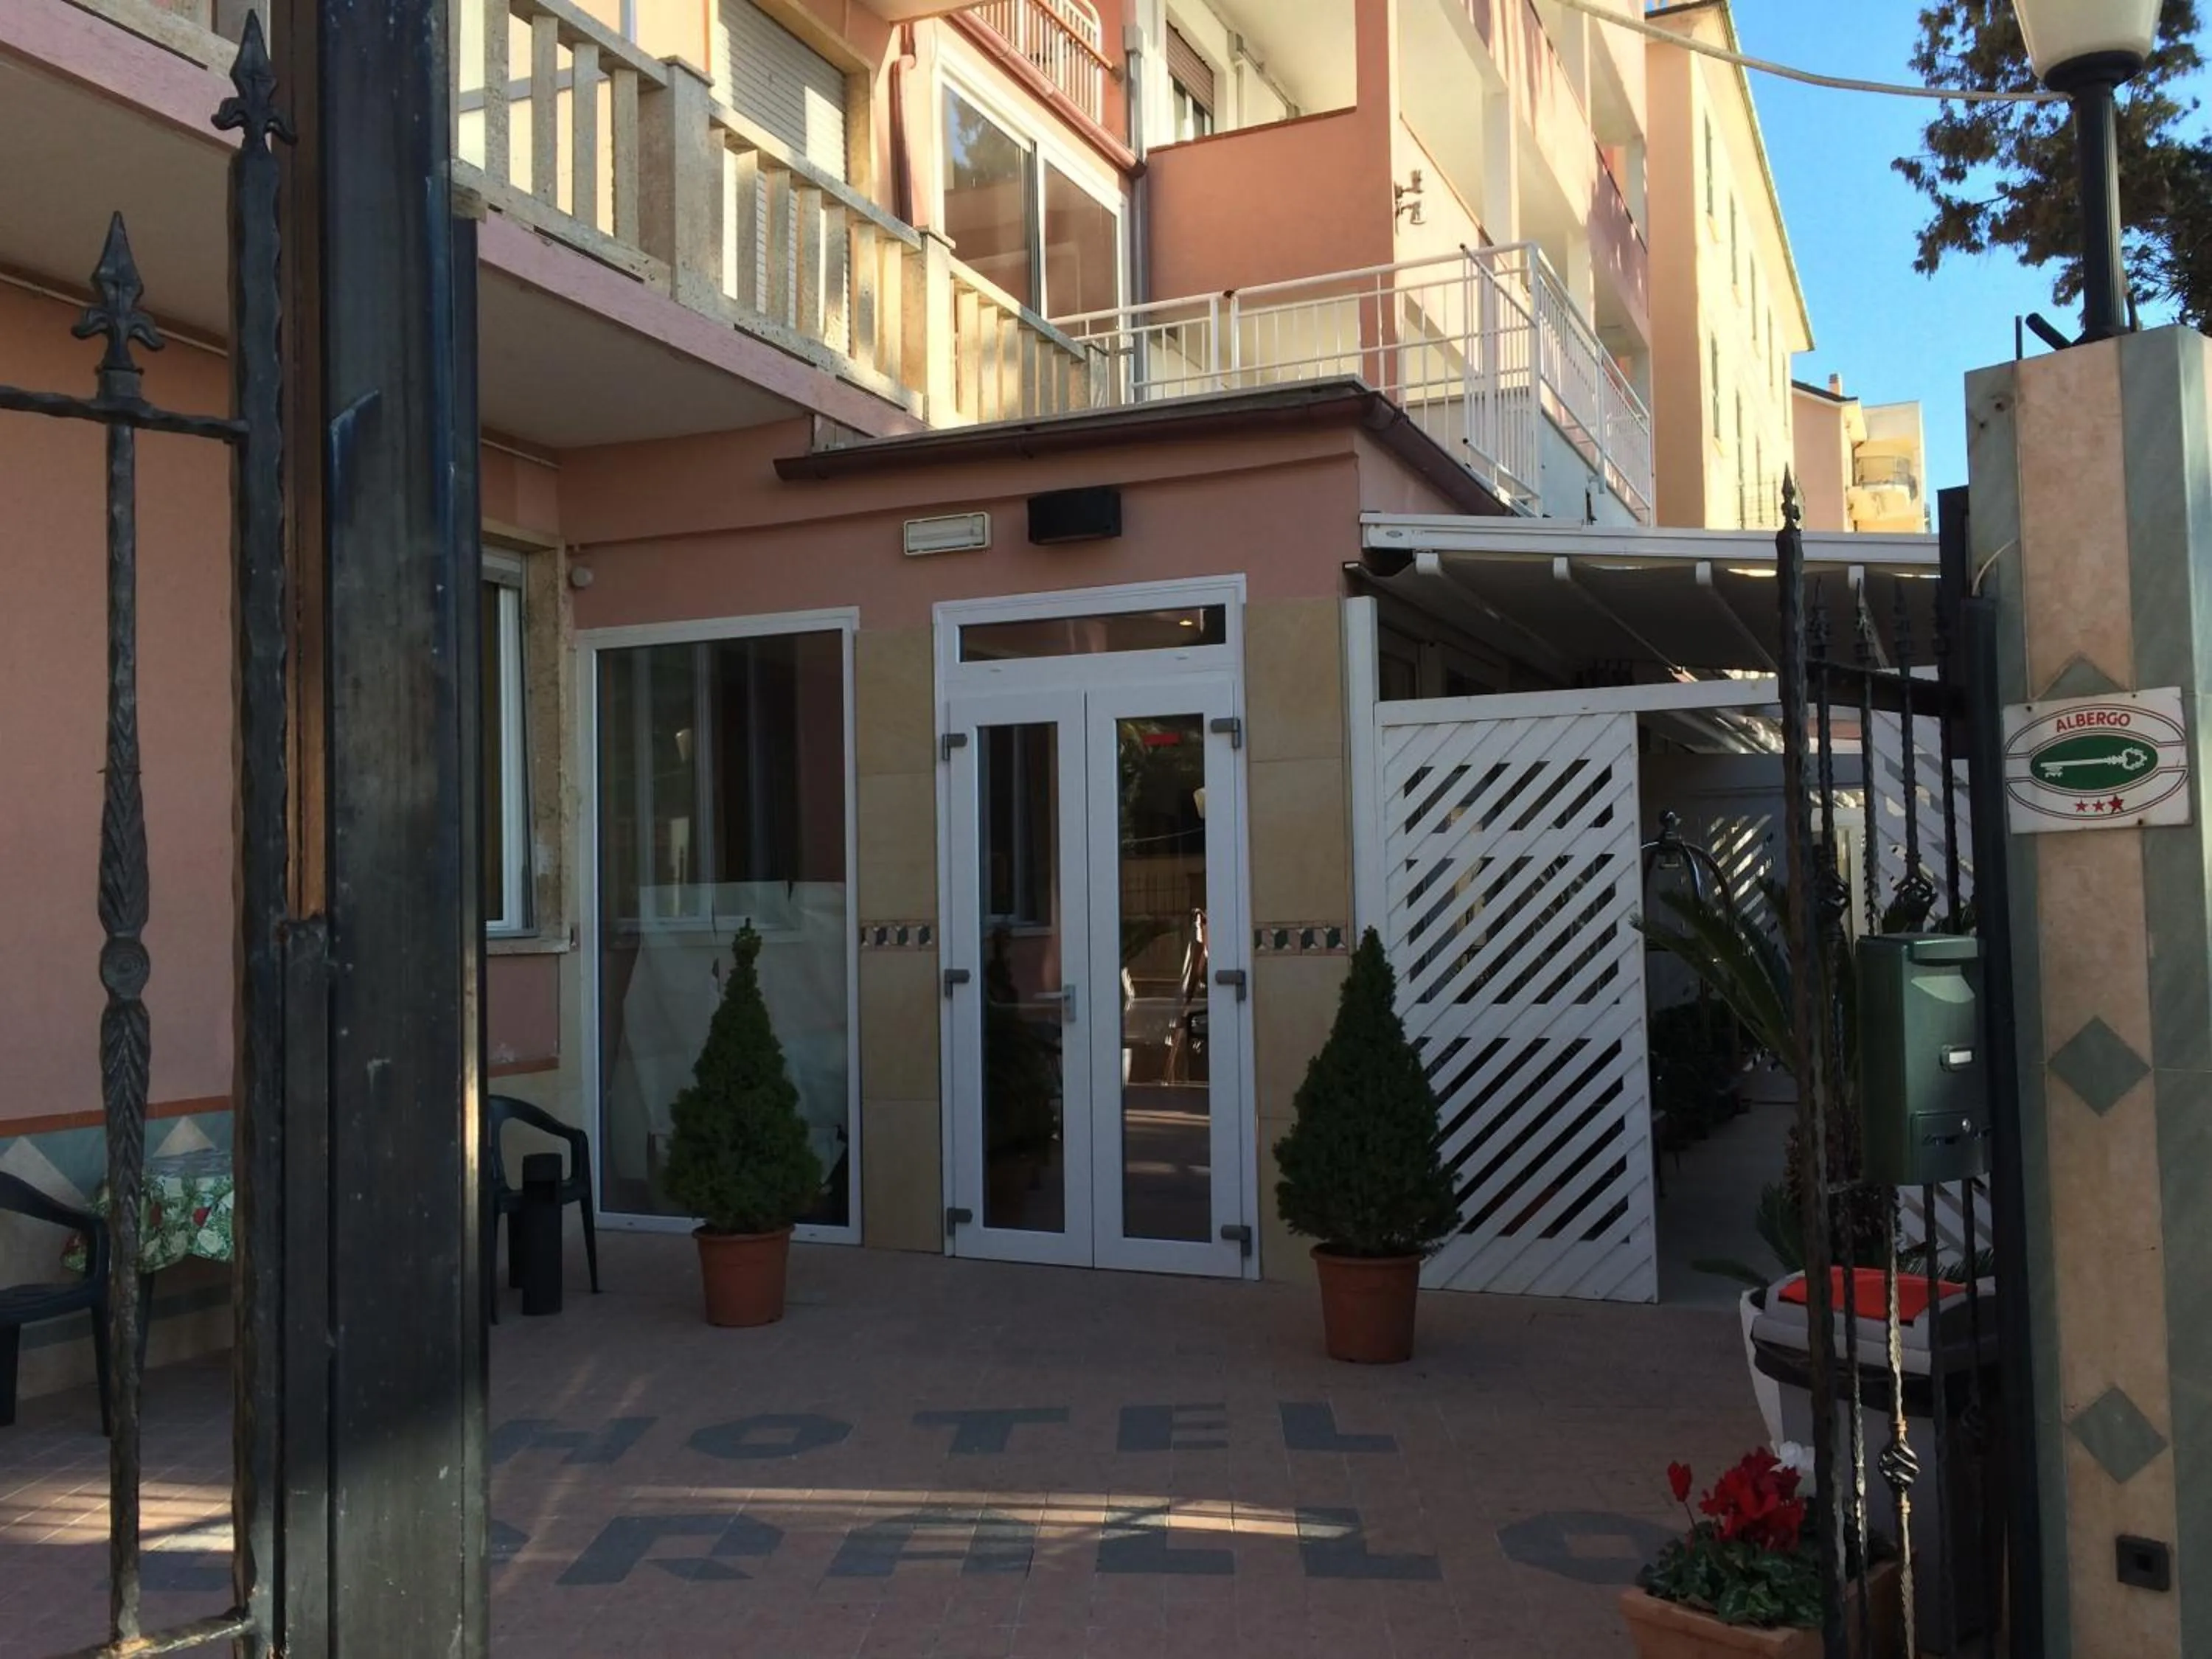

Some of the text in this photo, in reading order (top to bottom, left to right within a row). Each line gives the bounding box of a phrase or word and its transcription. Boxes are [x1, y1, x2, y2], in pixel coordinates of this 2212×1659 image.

[2056, 712, 2131, 732] ALBERGO
[490, 1402, 1397, 1464] HOTEL
[92, 1508, 1690, 1591] RALLO
